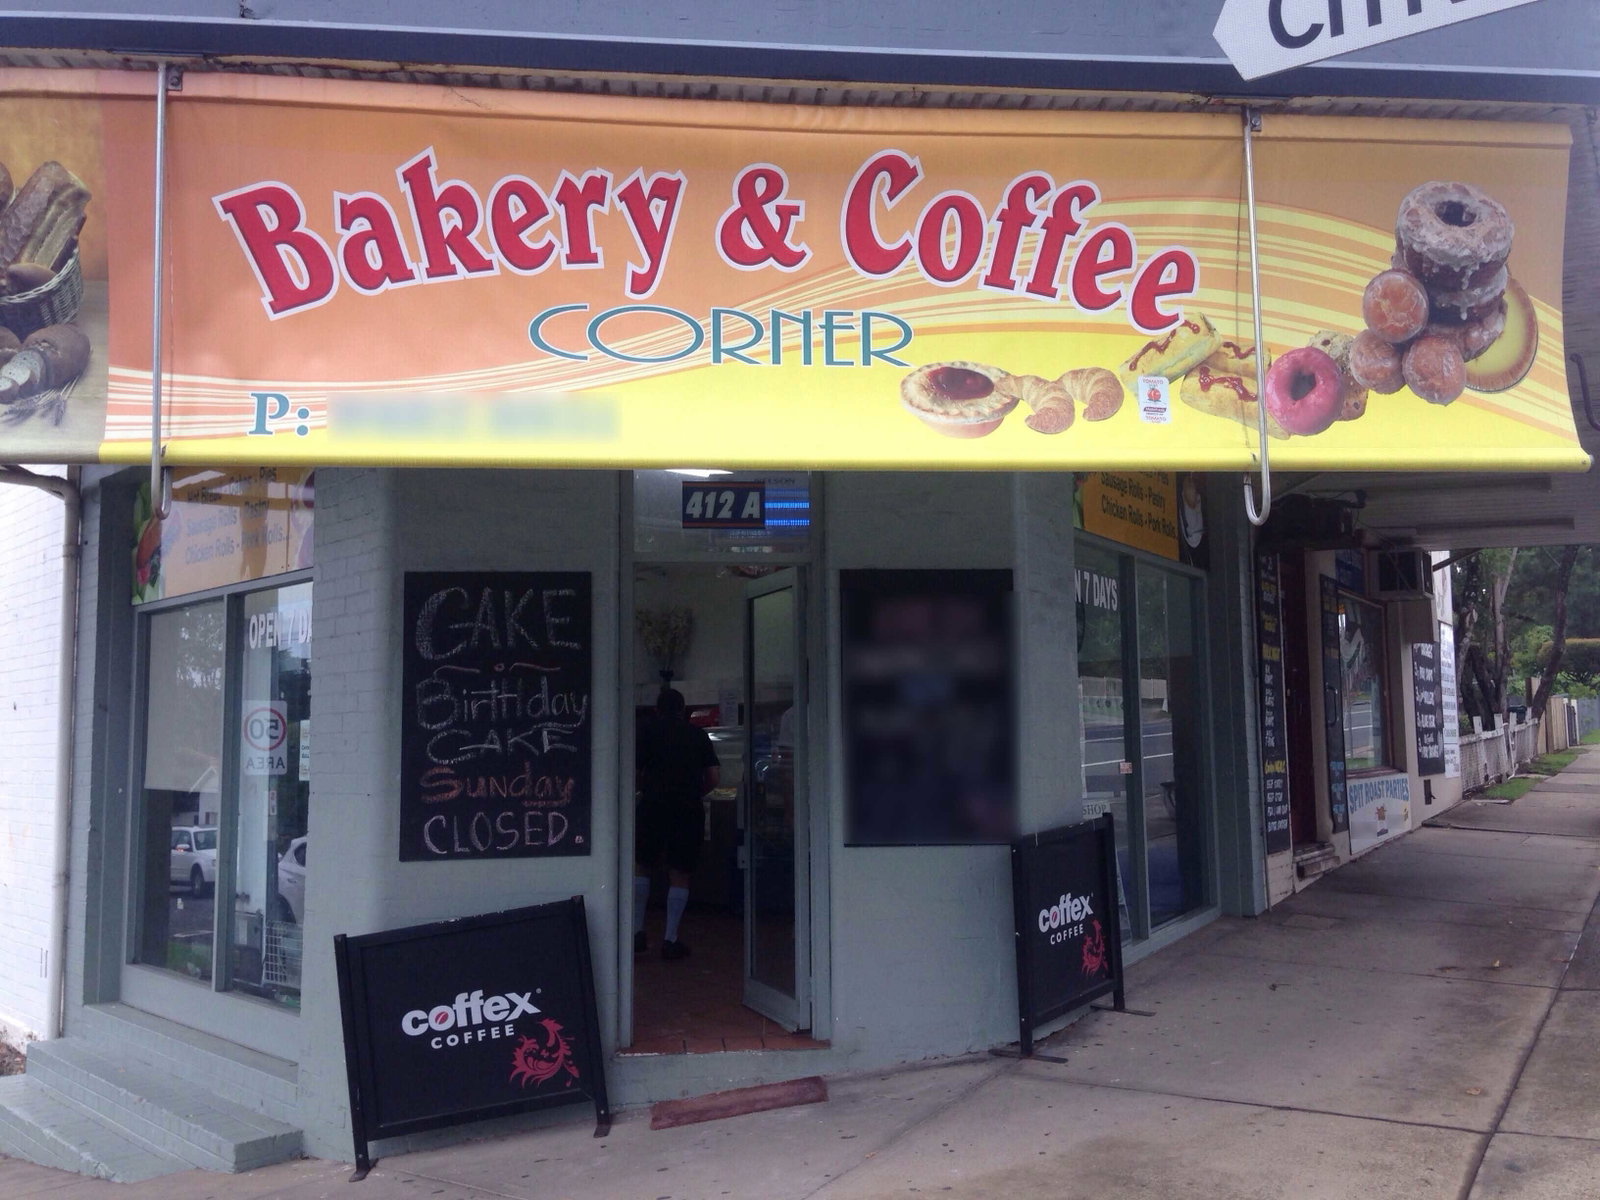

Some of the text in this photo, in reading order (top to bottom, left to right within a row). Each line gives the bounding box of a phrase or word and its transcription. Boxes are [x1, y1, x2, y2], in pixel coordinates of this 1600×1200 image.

[212, 145, 1199, 335] Bakery & Coffee
[529, 304, 914, 367] CORNER
[248, 392, 311, 436] P:
[686, 490, 761, 519] 412 A
[1083, 571, 1090, 605] 7
[1093, 573, 1118, 611] DAYS
[249, 612, 282, 650] OPEN
[1349, 783, 1365, 815] SPIT
[1365, 780, 1385, 805] ROAST
[1385, 777, 1410, 803] PARTIES
[1038, 892, 1093, 933] coffex
[1050, 923, 1084, 945] COFFEE
[402, 989, 542, 1036] coffex
[430, 1024, 515, 1049] COFFEE
